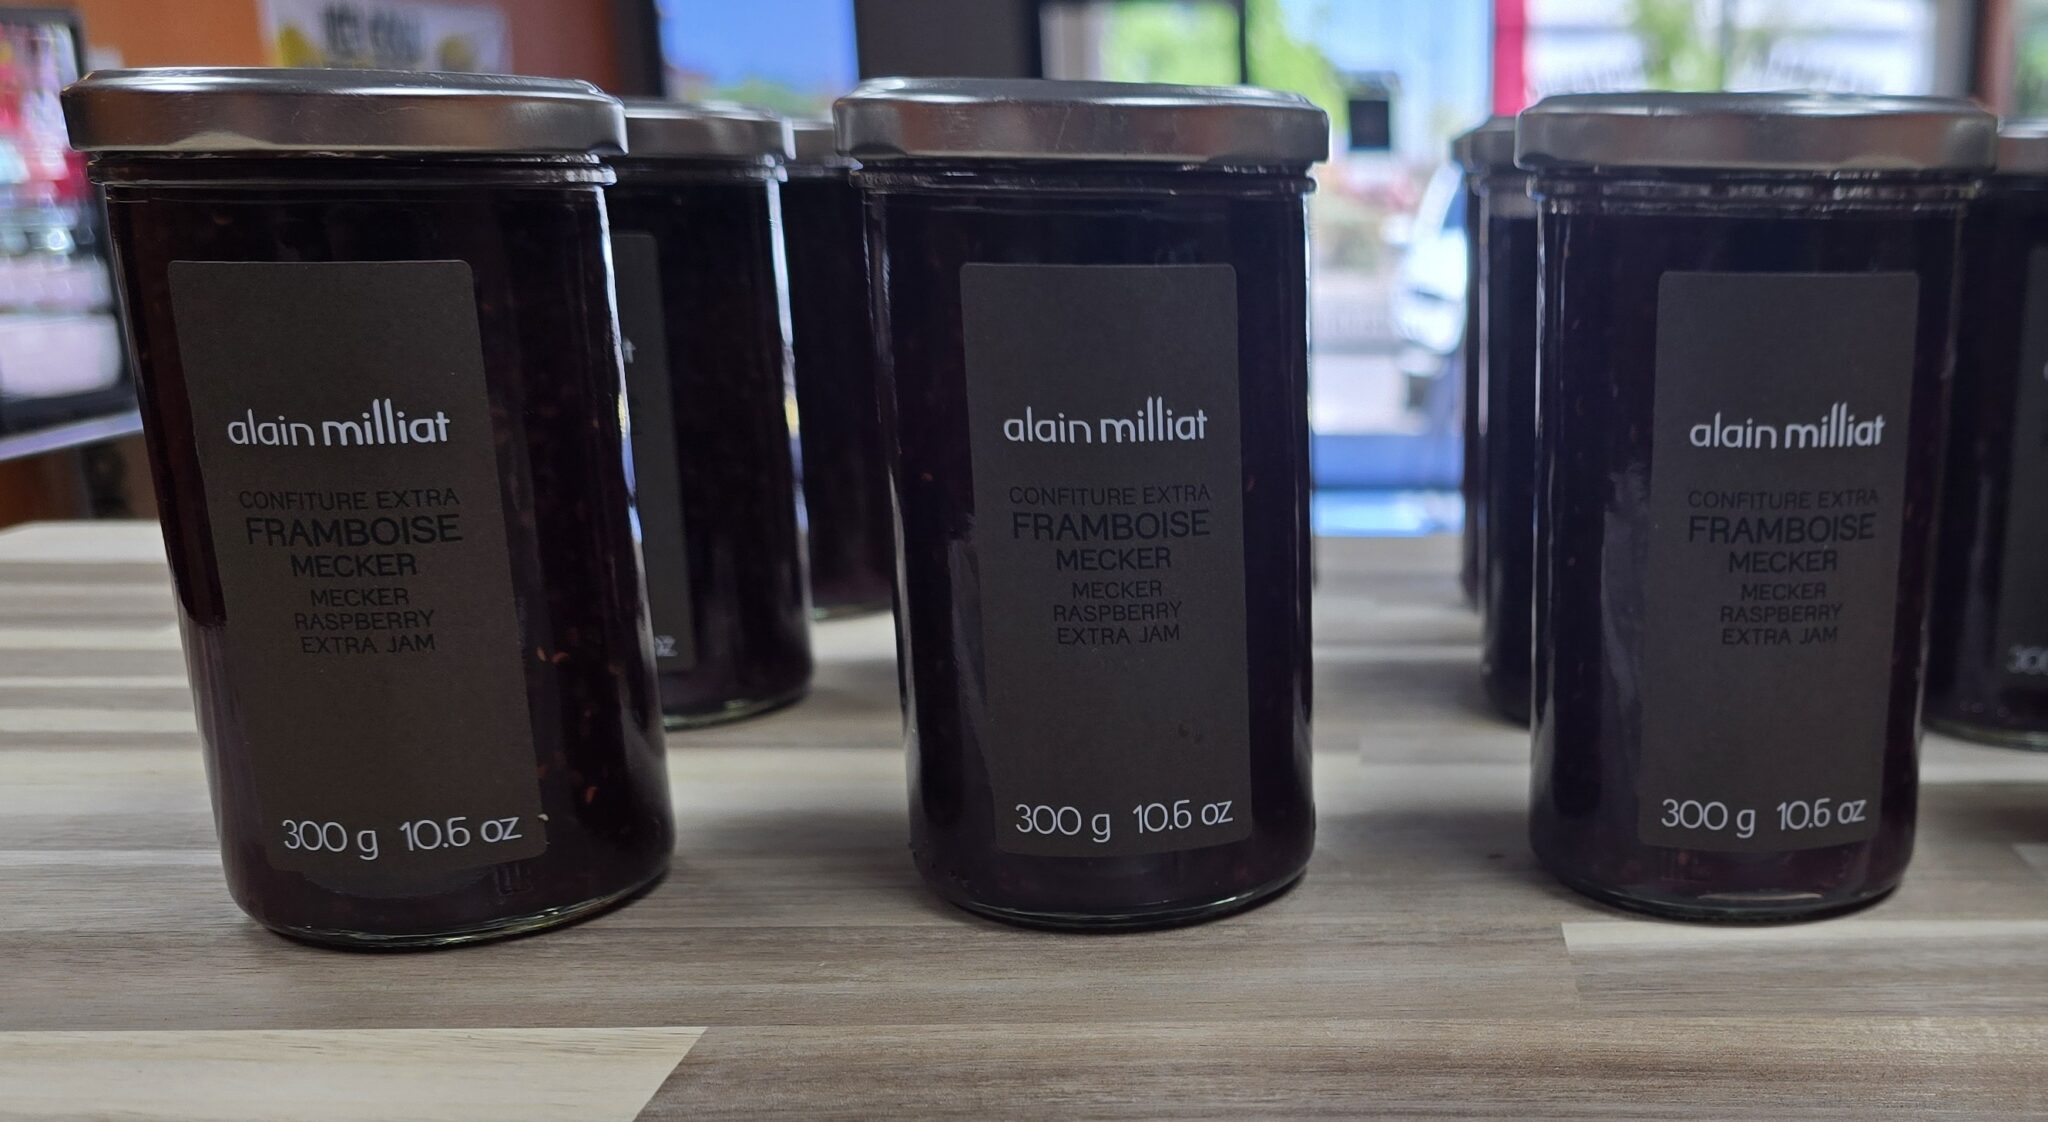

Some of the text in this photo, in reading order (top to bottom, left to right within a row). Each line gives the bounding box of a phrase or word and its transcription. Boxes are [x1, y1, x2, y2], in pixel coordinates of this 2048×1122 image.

[228, 398, 450, 446] alain milliat
[1003, 396, 1208, 443] alain milliat
[1689, 401, 1885, 449] alain milliat
[239, 488, 460, 511] CONFITURE EXTRA
[1009, 484, 1211, 506] CONFITURE EXTRA
[1688, 488, 1879, 510] CONFITURE EXTRA
[246, 514, 463, 547] FRAMBOISE
[1012, 509, 1211, 541] FRAMBOISE
[1688, 512, 1877, 544] FRAMBOISE
[290, 553, 417, 578] MECKER
[1056, 547, 1171, 571] MECKER
[1728, 550, 1838, 573] MECKER
[310, 587, 410, 607] MECKER
[1073, 580, 1162, 599] MECKER
[1741, 583, 1826, 600] MECKER
[294, 609, 434, 631] RASPBERRY
[1054, 601, 1182, 622] RASPBERRY
[1720, 603, 1843, 623] RASPBERRY
[302, 633, 436, 654] EXTRA JAM
[1057, 624, 1180, 645] EXTRA JAM
[1722, 627, 1838, 645] EXTRA JAM
[1015, 800, 1233, 843] 300 g 10.6 oz
[1661, 798, 1866, 838] 300 g 10.6 oz
[282, 816, 522, 860] 300 g 10.6 oz
